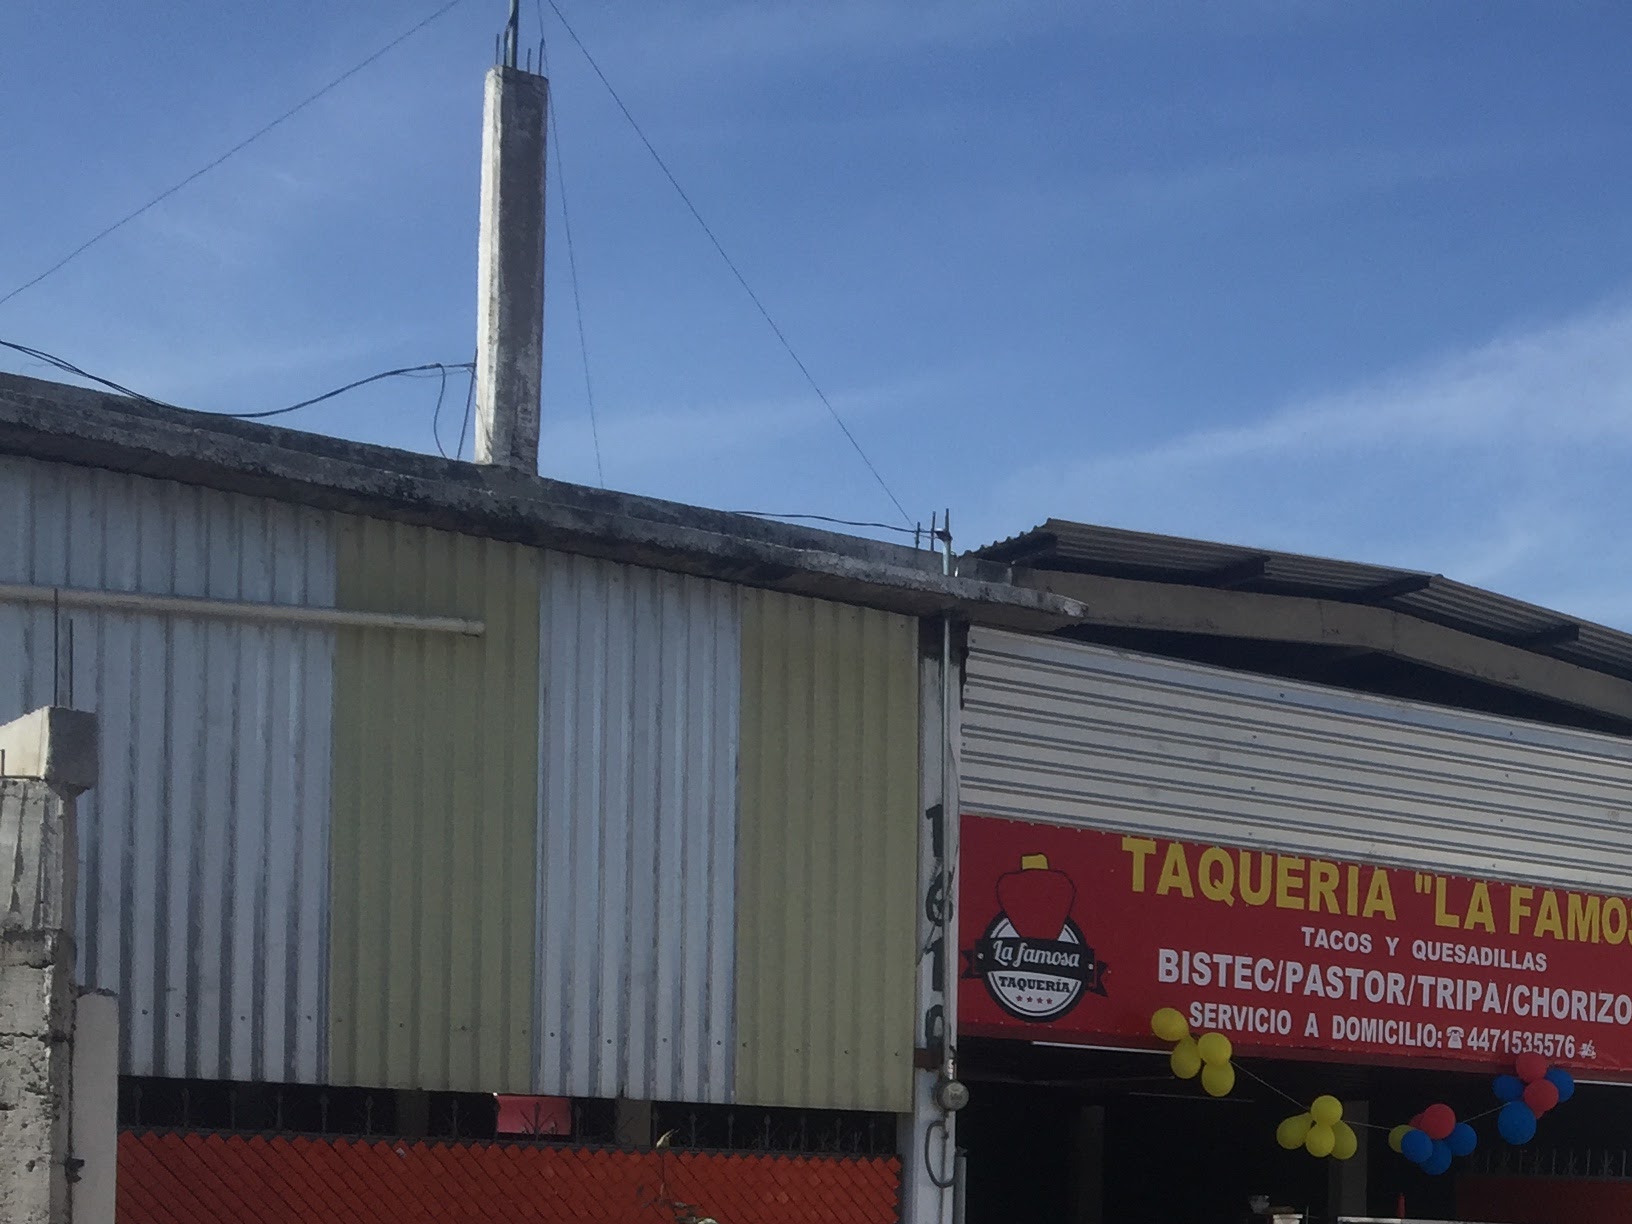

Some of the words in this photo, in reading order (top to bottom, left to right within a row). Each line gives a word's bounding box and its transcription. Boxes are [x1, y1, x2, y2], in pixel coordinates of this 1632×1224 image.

[1122, 837, 1397, 920] TAQUERIA
[1415, 871, 1496, 933] "LA
[992, 939, 1013, 967] La
[1012, 941, 1080, 968] famosa
[1301, 926, 1373, 954] TACOS
[1385, 936, 1399, 956] Y
[1412, 939, 1547, 972] QUESADILLAS
[999, 976, 1071, 993] TAQUERÍA
[1158, 948, 1632, 1025] BISTEC/PASTOR/TRIPA/CHORIZO
[1189, 1001, 1292, 1035] SERVICIO
[1304, 1012, 1319, 1038] A
[1332, 1015, 1443, 1048] DOMICILIO:
[1467, 1027, 1576, 1058] 4471535576
